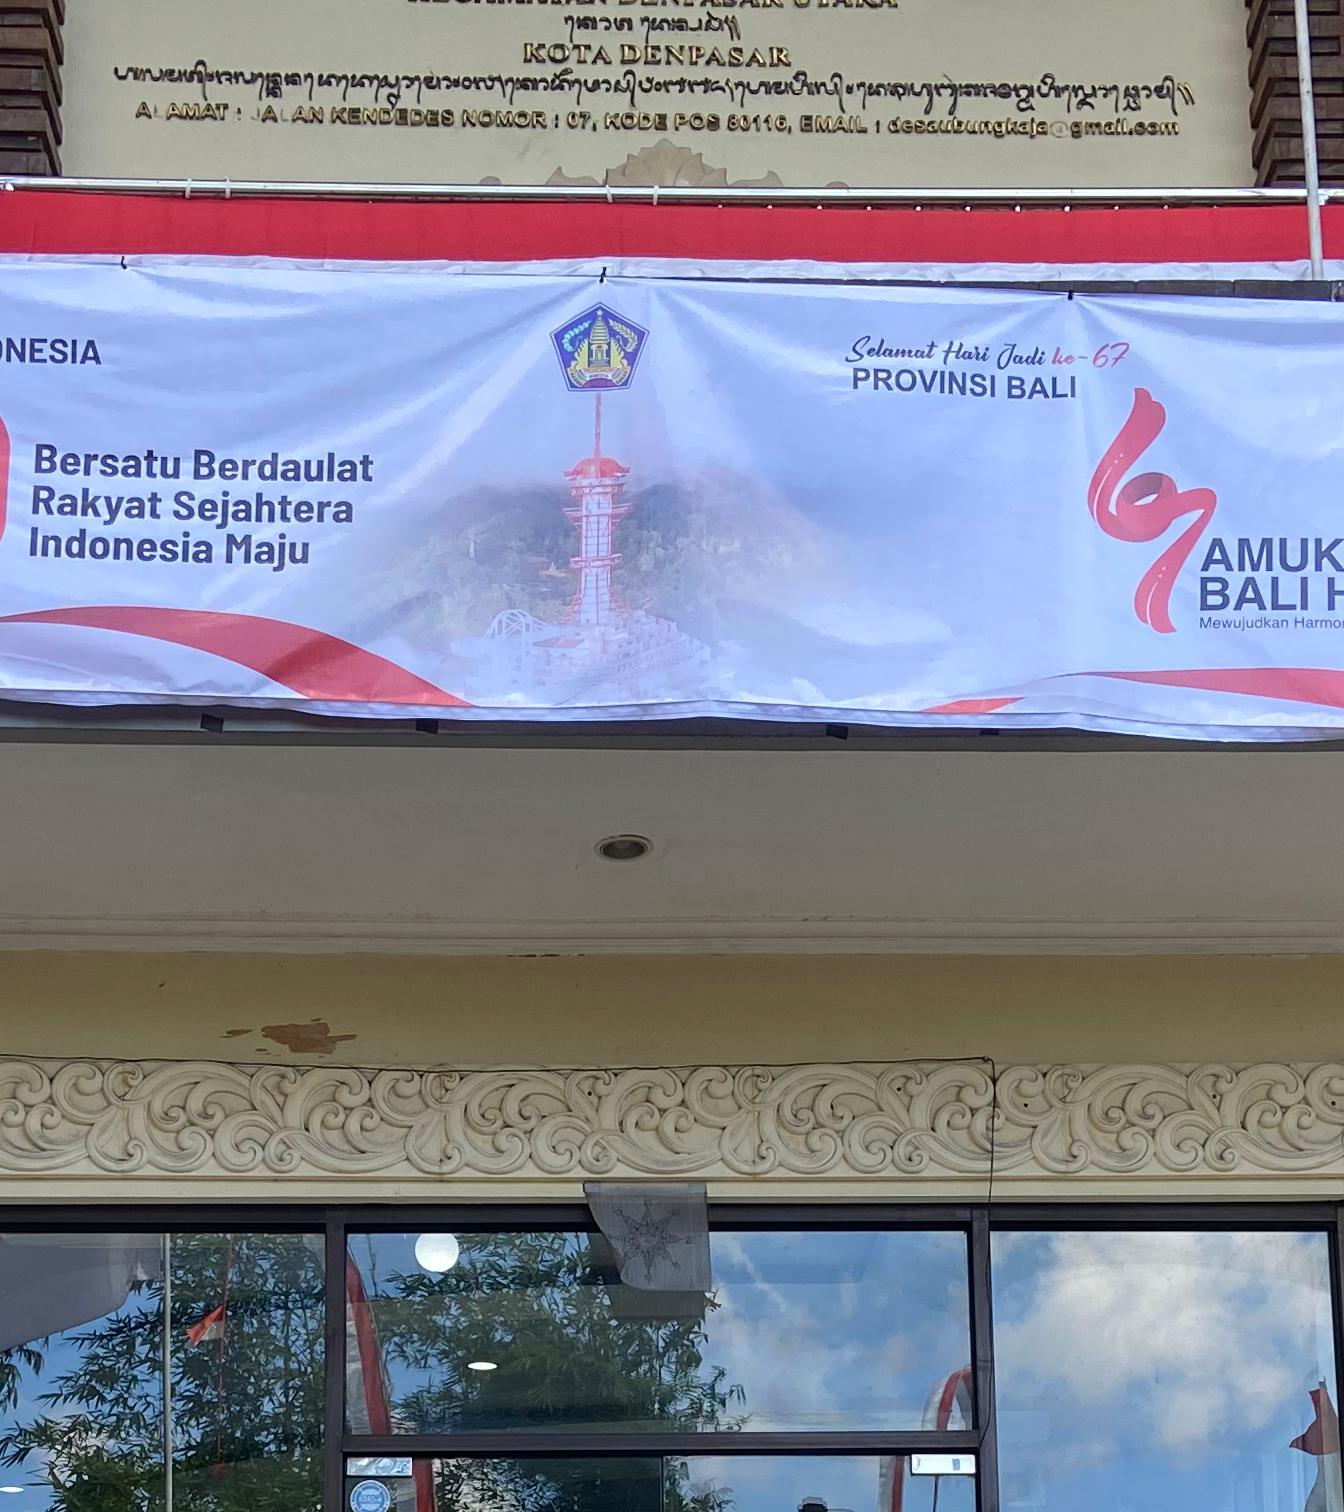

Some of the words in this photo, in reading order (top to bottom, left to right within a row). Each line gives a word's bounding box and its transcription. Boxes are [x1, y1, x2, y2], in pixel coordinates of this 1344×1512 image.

[523, 42, 612, 66] KOTA
[620, 43, 792, 67] DENPASAR
[331, 106, 454, 127] KENDEDES
[462, 109, 548, 129] NOMOR
[606, 111, 668, 131] KODE
[674, 112, 720, 132] POS
[800, 113, 867, 135] EMAIL
[844, 335, 937, 363] Selamat
[942, 340, 991, 366] Hari
[996, 343, 1046, 370] Jadi
[1051, 341, 1131, 369] ke-67
[852, 367, 996, 399] PROVINSI
[1006, 374, 1077, 400] BALI
[34, 443, 181, 480] Bersatu
[193, 449, 374, 483] Berdaulat
[31, 485, 162, 526] Rakyat
[172, 490, 354, 530] Sejahtera
[28, 526, 213, 564] Indonesia
[224, 532, 311, 572] Maju
[1199, 576, 1309, 612] BALI
[1199, 616, 1289, 631] Mewujudkan
